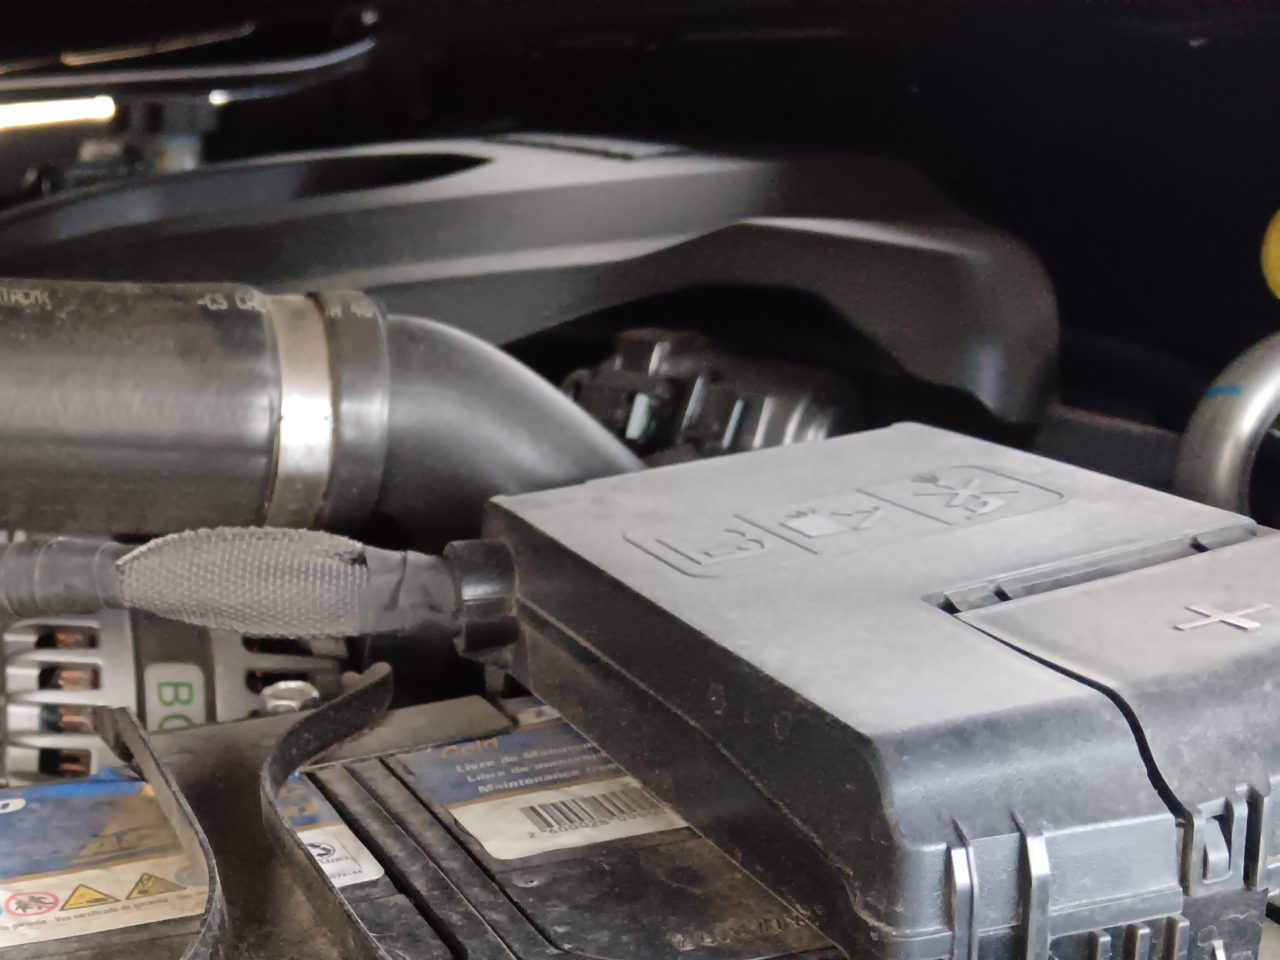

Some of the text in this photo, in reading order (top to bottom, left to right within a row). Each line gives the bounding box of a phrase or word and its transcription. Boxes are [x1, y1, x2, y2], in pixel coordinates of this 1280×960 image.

[455, 759, 495, 774] Livre
[501, 755, 517, 763] de
[466, 770, 505, 783] Libre
[510, 765, 529, 775] de
[478, 769, 580, 794] Maintenance
